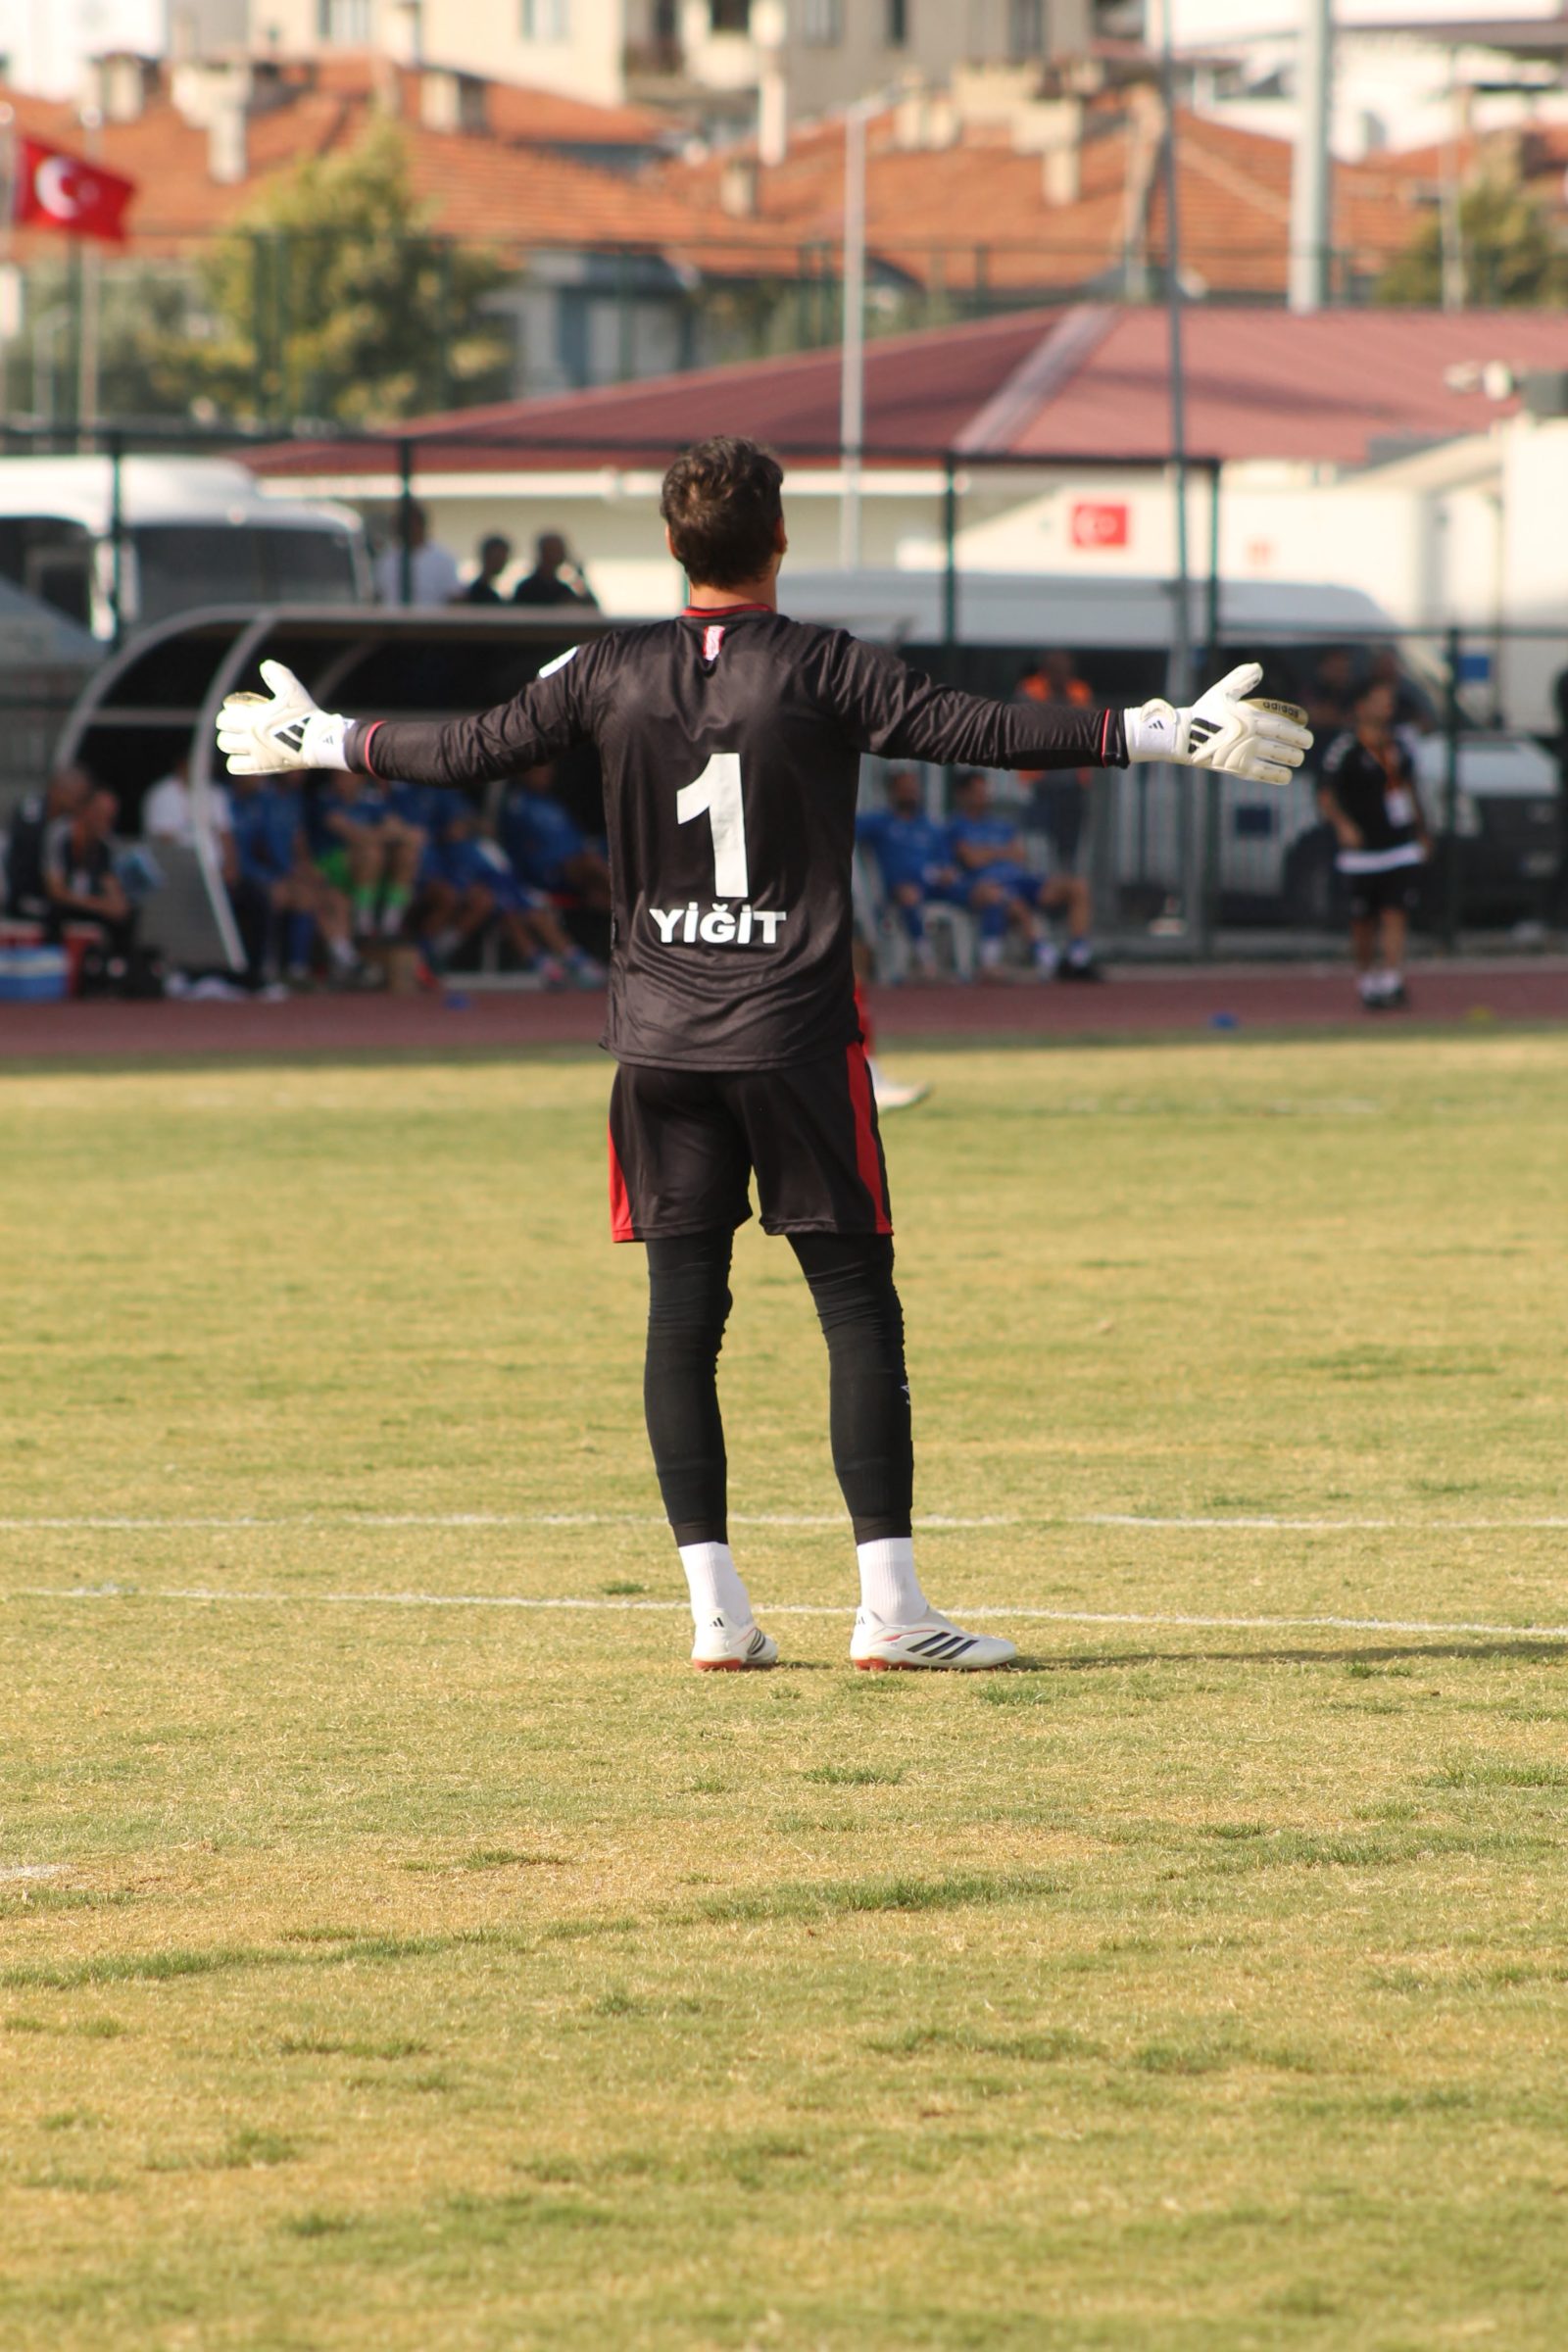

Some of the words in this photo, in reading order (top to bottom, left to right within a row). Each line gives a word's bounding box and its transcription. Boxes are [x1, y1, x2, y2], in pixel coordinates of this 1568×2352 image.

[1262, 700, 1299, 718] adidas
[676, 753, 748, 898] 1
[649, 902, 786, 944] YİĞİT
